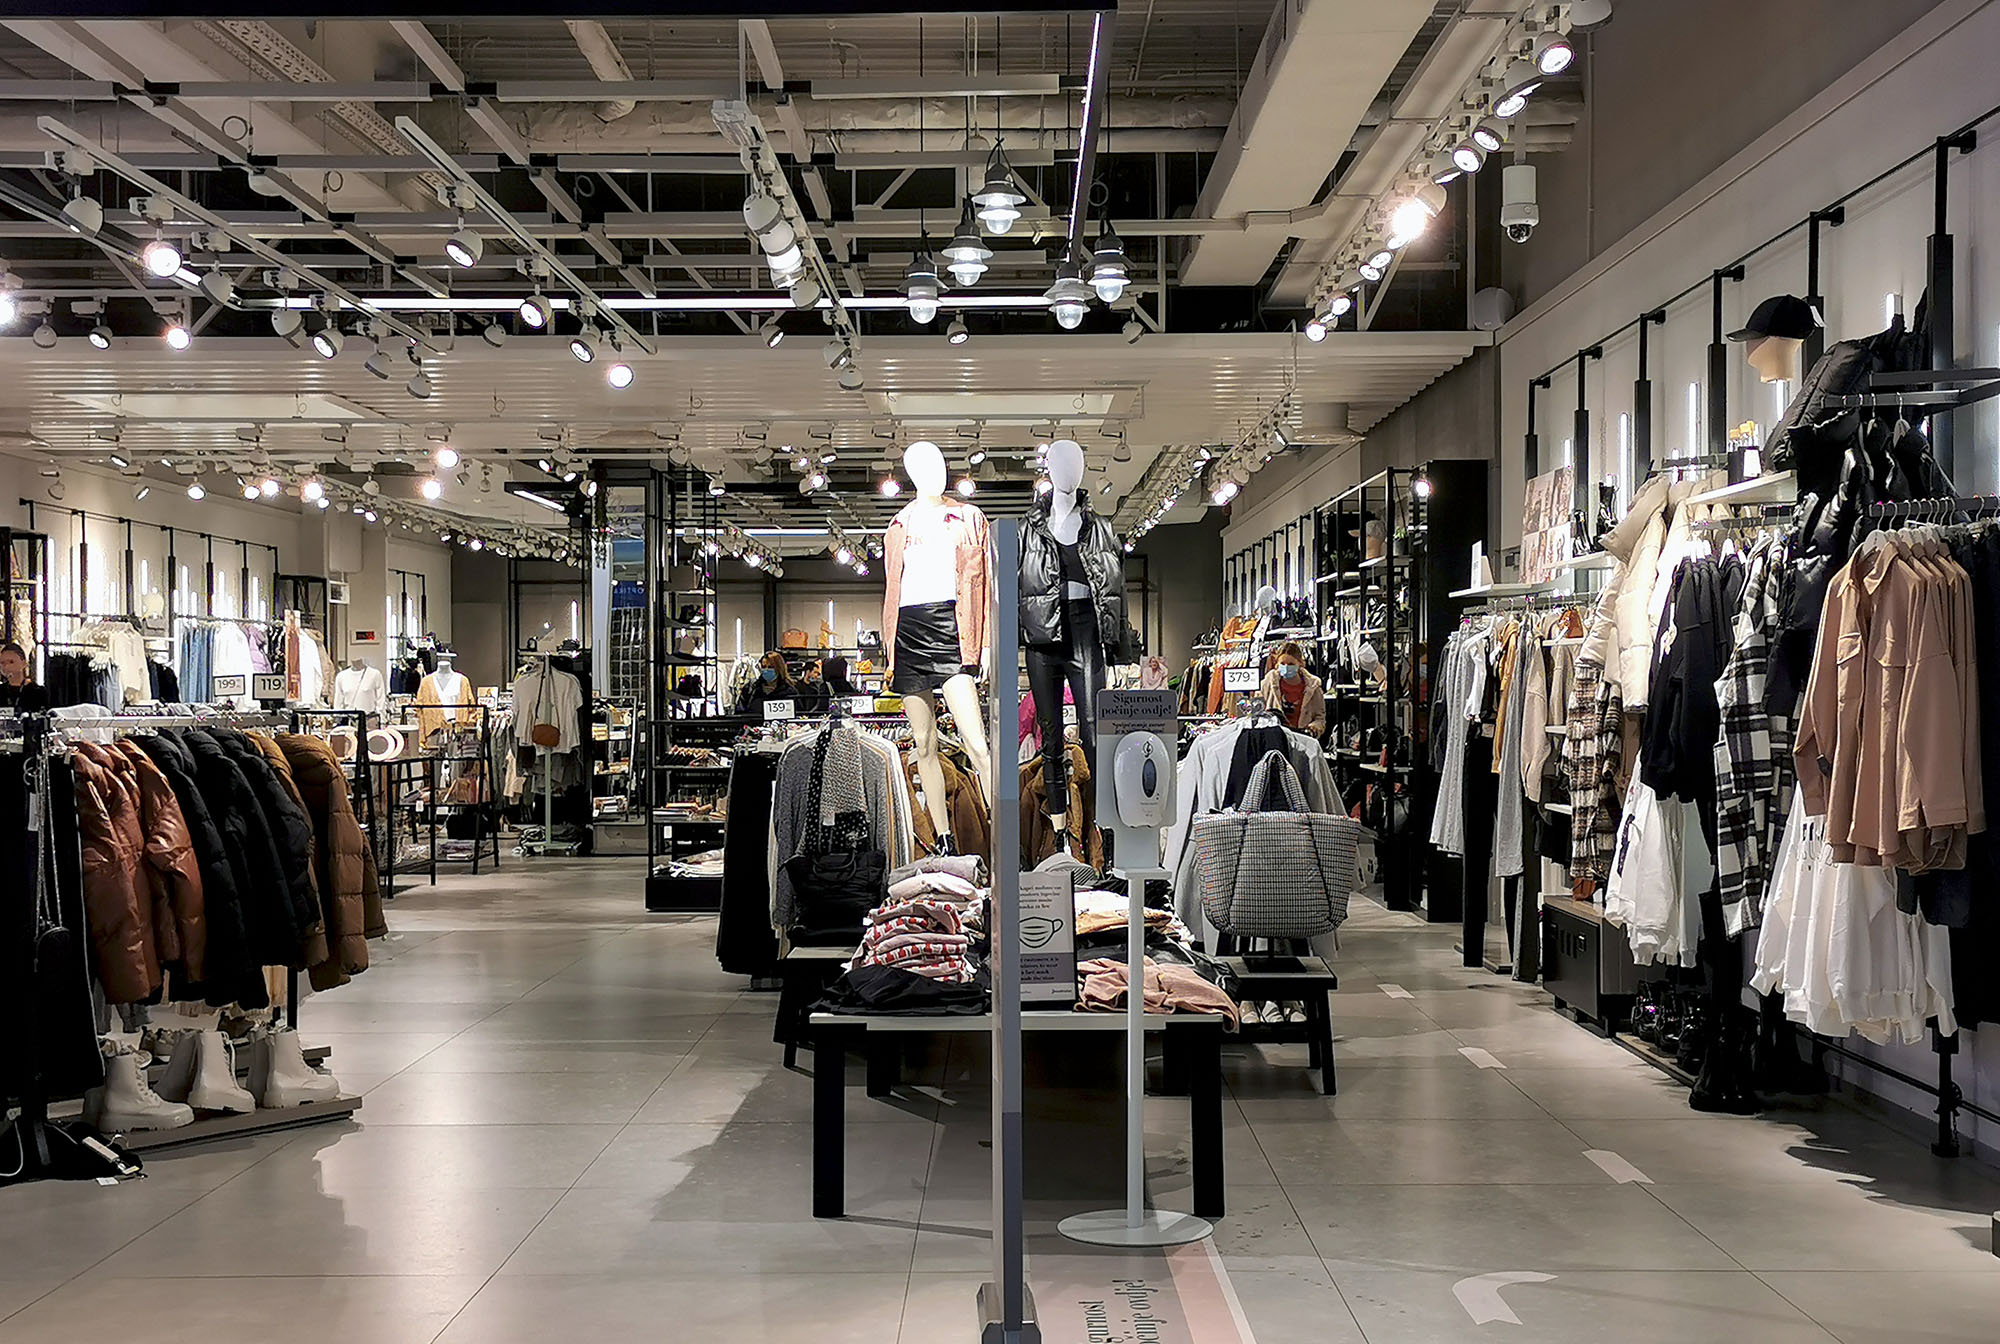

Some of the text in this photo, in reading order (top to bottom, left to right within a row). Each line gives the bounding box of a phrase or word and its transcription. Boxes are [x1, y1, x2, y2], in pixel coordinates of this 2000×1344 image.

[1228, 671, 1250, 683] 379
[217, 679, 236, 689] 199
[261, 678, 282, 691] 119
[1112, 691, 1163, 706] Sigurnost
[767, 702, 786, 713] 139
[1101, 704, 1173, 718] počinje ovdje!
[1112, 1279, 1168, 1344] činje ovdje!
[1078, 1300, 1124, 1344] gurnost
